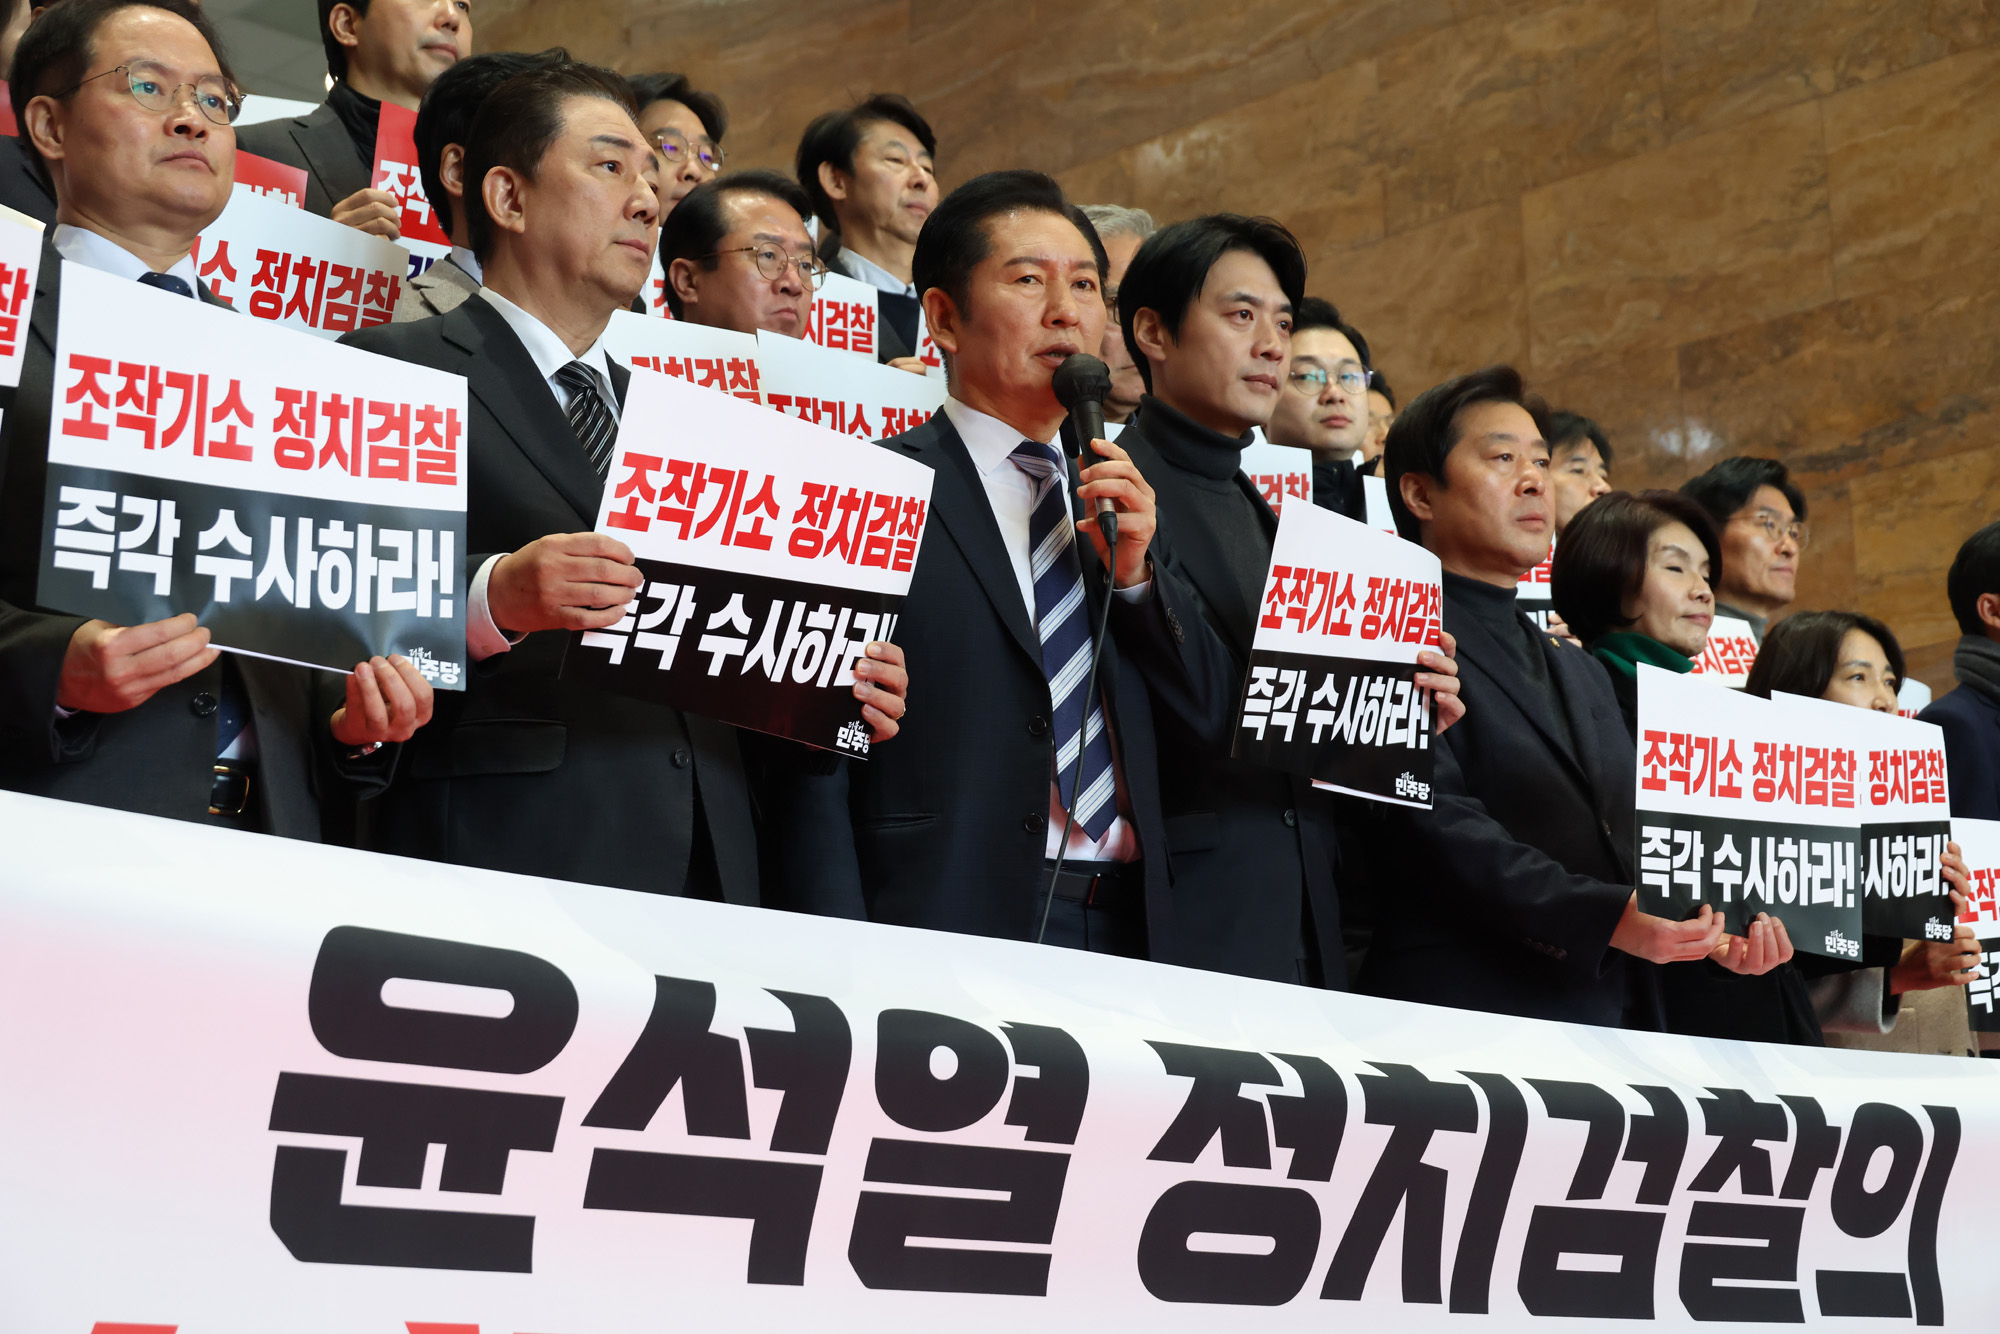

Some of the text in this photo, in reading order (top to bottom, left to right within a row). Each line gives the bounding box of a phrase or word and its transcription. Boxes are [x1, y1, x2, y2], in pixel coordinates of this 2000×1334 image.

[250, 248, 401, 332] 정치검찰
[62, 353, 462, 486] 조작기소 정치검찰
[53, 485, 455, 619] 즉각 수사하라!
[606, 452, 925, 573] 조작기소 정치검찰
[1261, 565, 1442, 646] 조작기소 정치검찰
[1242, 666, 1430, 749] 즉각 수사하라!
[1396, 778, 1430, 800] 민주당
[1642, 730, 1857, 808] 조작기소 정치검찰
[1869, 749, 1946, 806] 정치검찰
[1641, 826, 1855, 907] 즉각 수사하라!
[1861, 834, 1950, 899] 사하라!
[1825, 936, 1859, 957] 민주당
[1925, 922, 1952, 940] 민주당
[268, 925, 1961, 1326] 윤석열 정치검찰의
